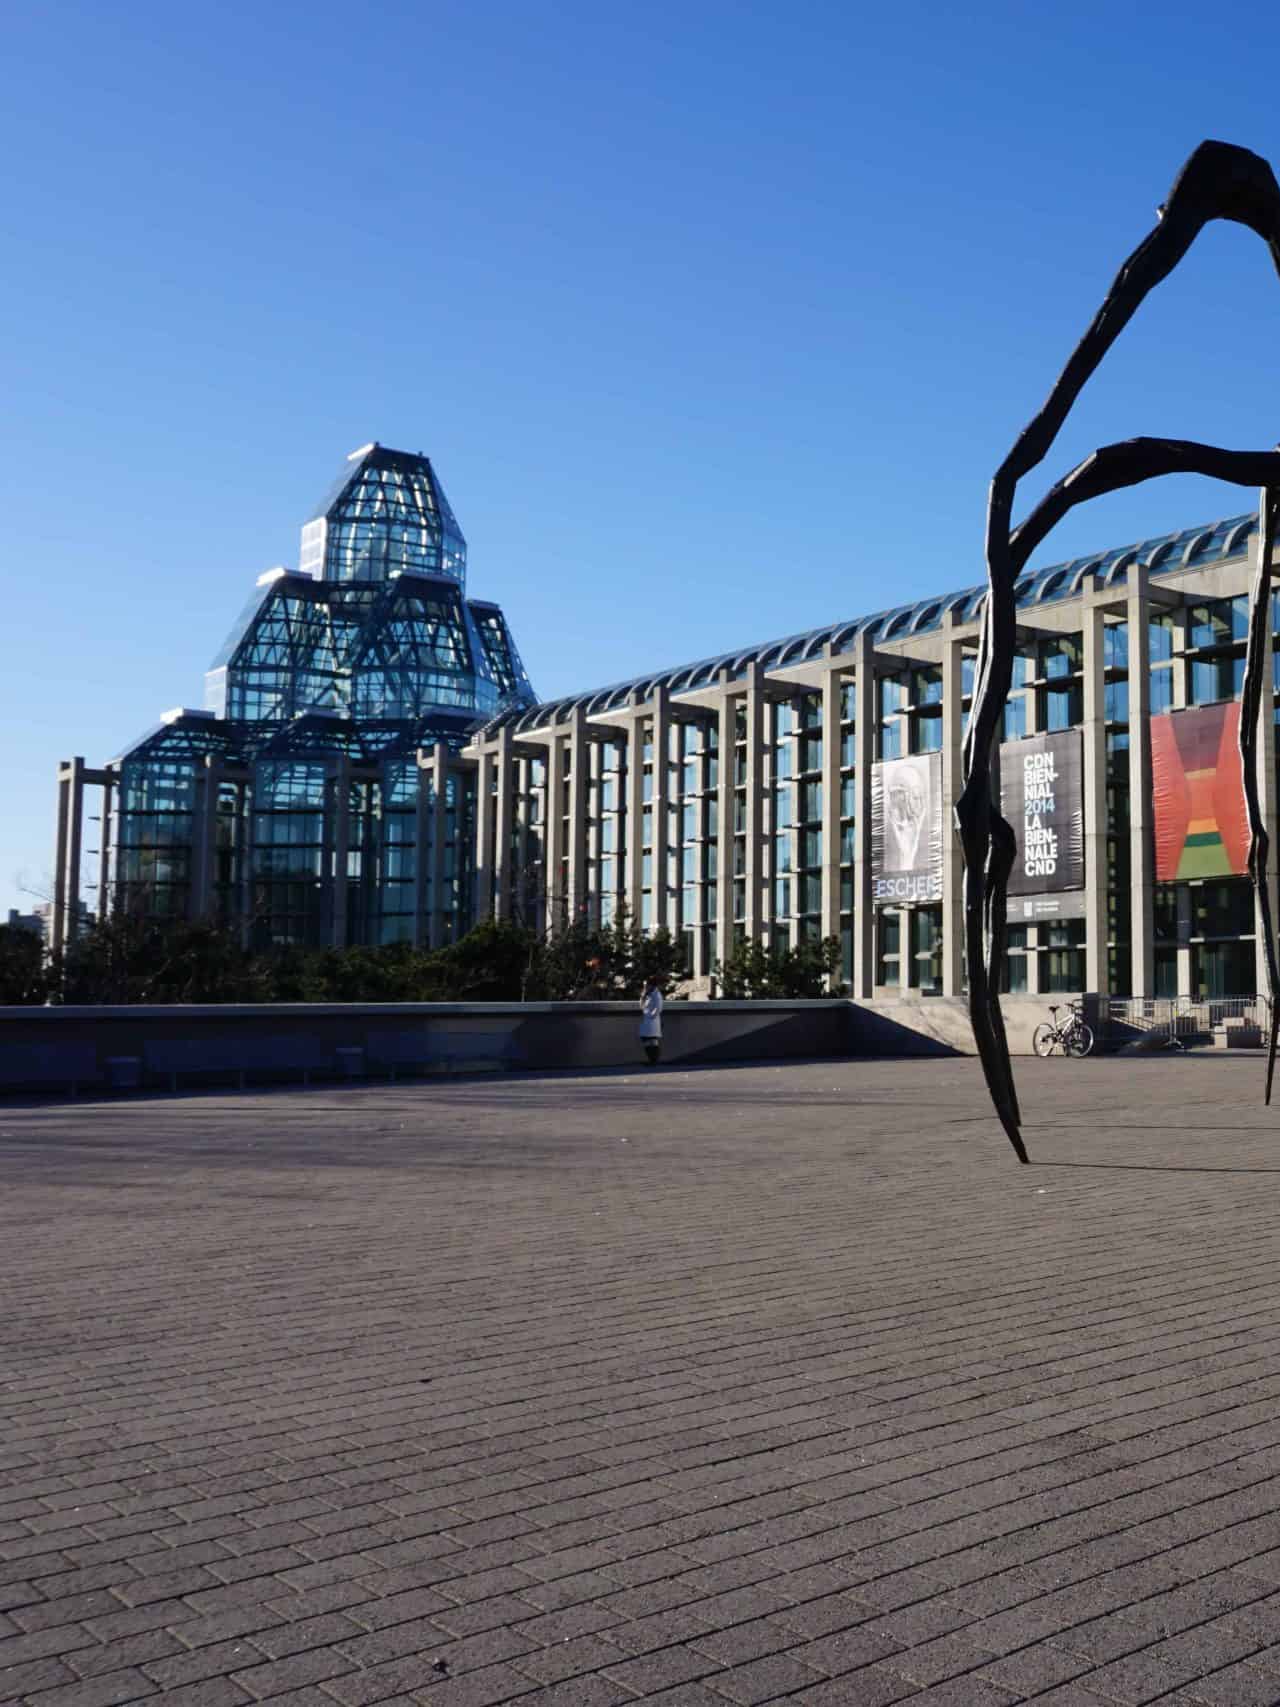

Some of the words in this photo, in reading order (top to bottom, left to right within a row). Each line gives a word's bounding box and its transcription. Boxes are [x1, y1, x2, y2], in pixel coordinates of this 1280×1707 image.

[1023, 767, 1059, 786] BIEN-
[1023, 782, 1055, 800] NIAL
[1024, 798, 1055, 816] 2014
[1024, 814, 1042, 830] LA
[1025, 828, 1058, 846] BIEN-
[1025, 843, 1058, 861] NALE
[1025, 859, 1056, 877] CND
